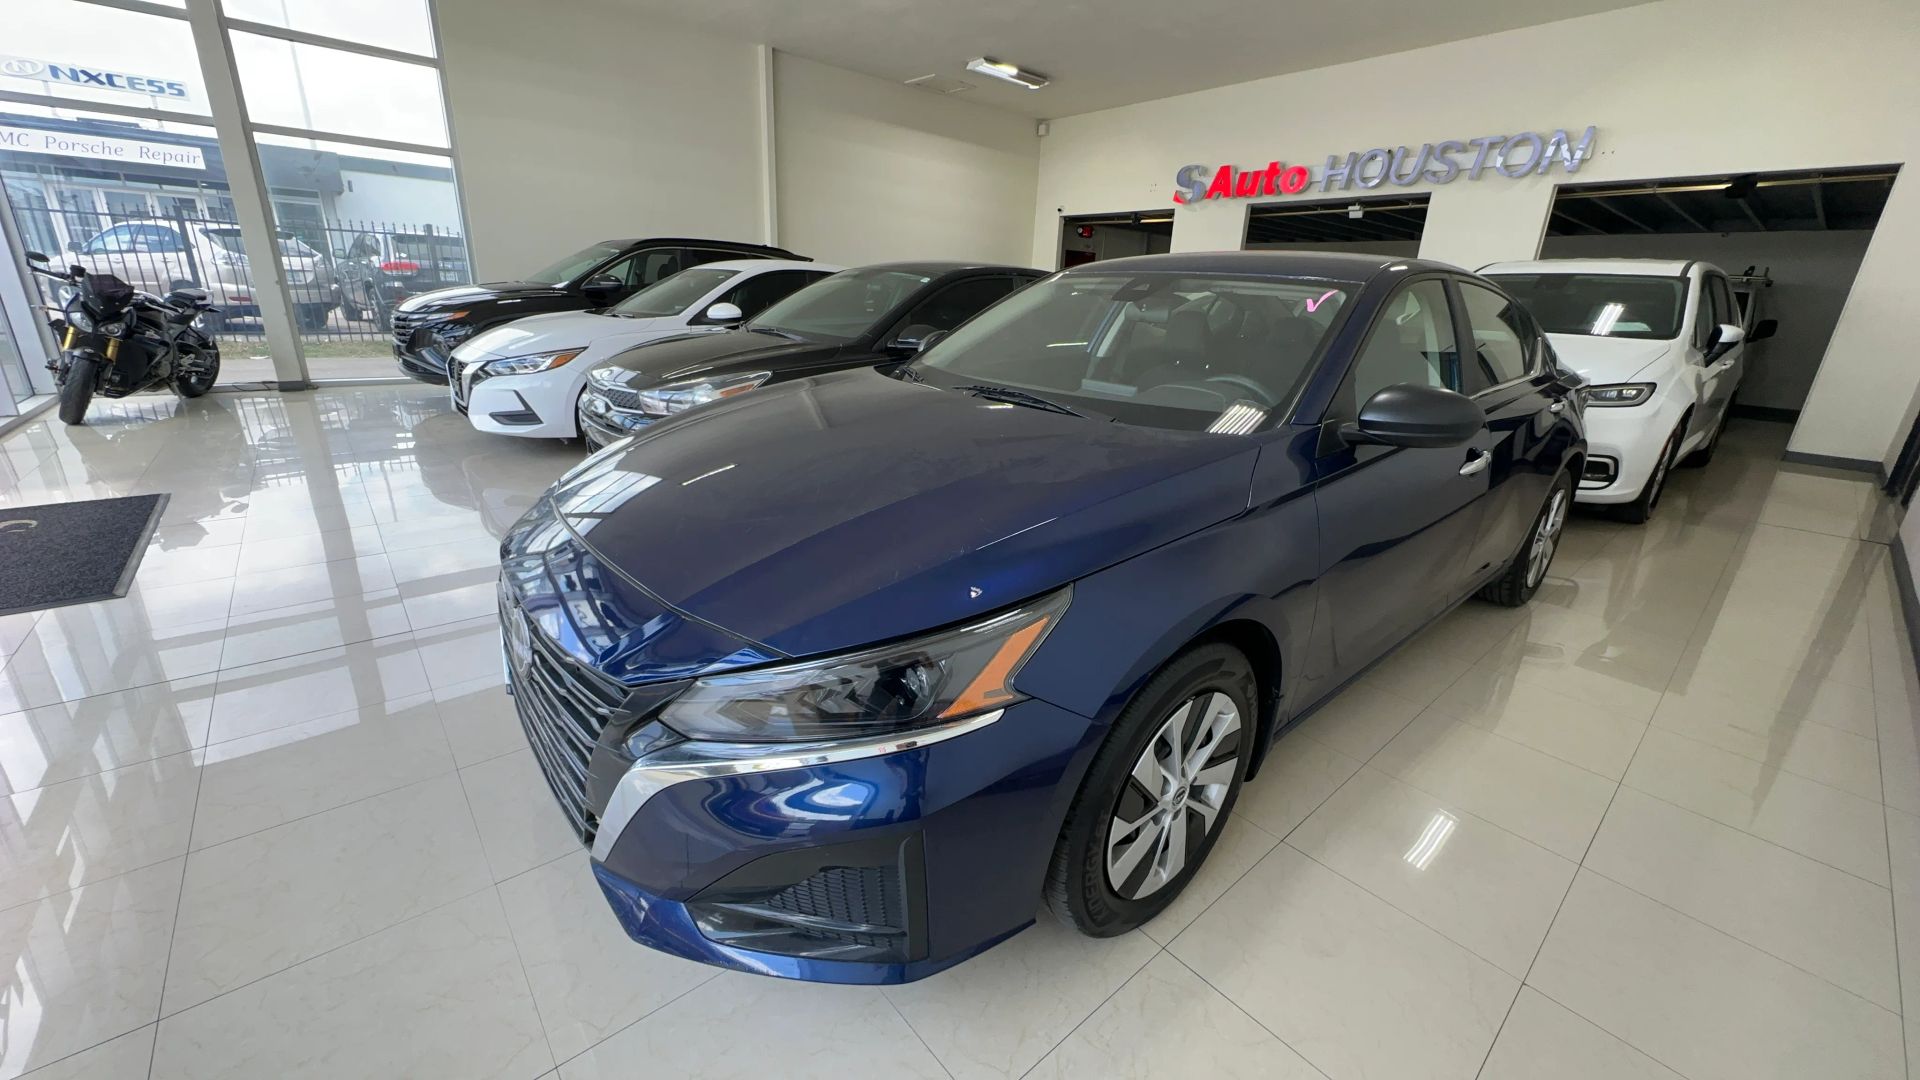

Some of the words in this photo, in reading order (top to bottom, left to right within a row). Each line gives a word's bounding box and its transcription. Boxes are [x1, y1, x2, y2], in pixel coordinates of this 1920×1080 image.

[49, 64, 186, 97] NXCESS
[45, 135, 124, 157] Porsche
[139, 145, 200, 165] Repair
[1318, 125, 1597, 192] HOUSTON
